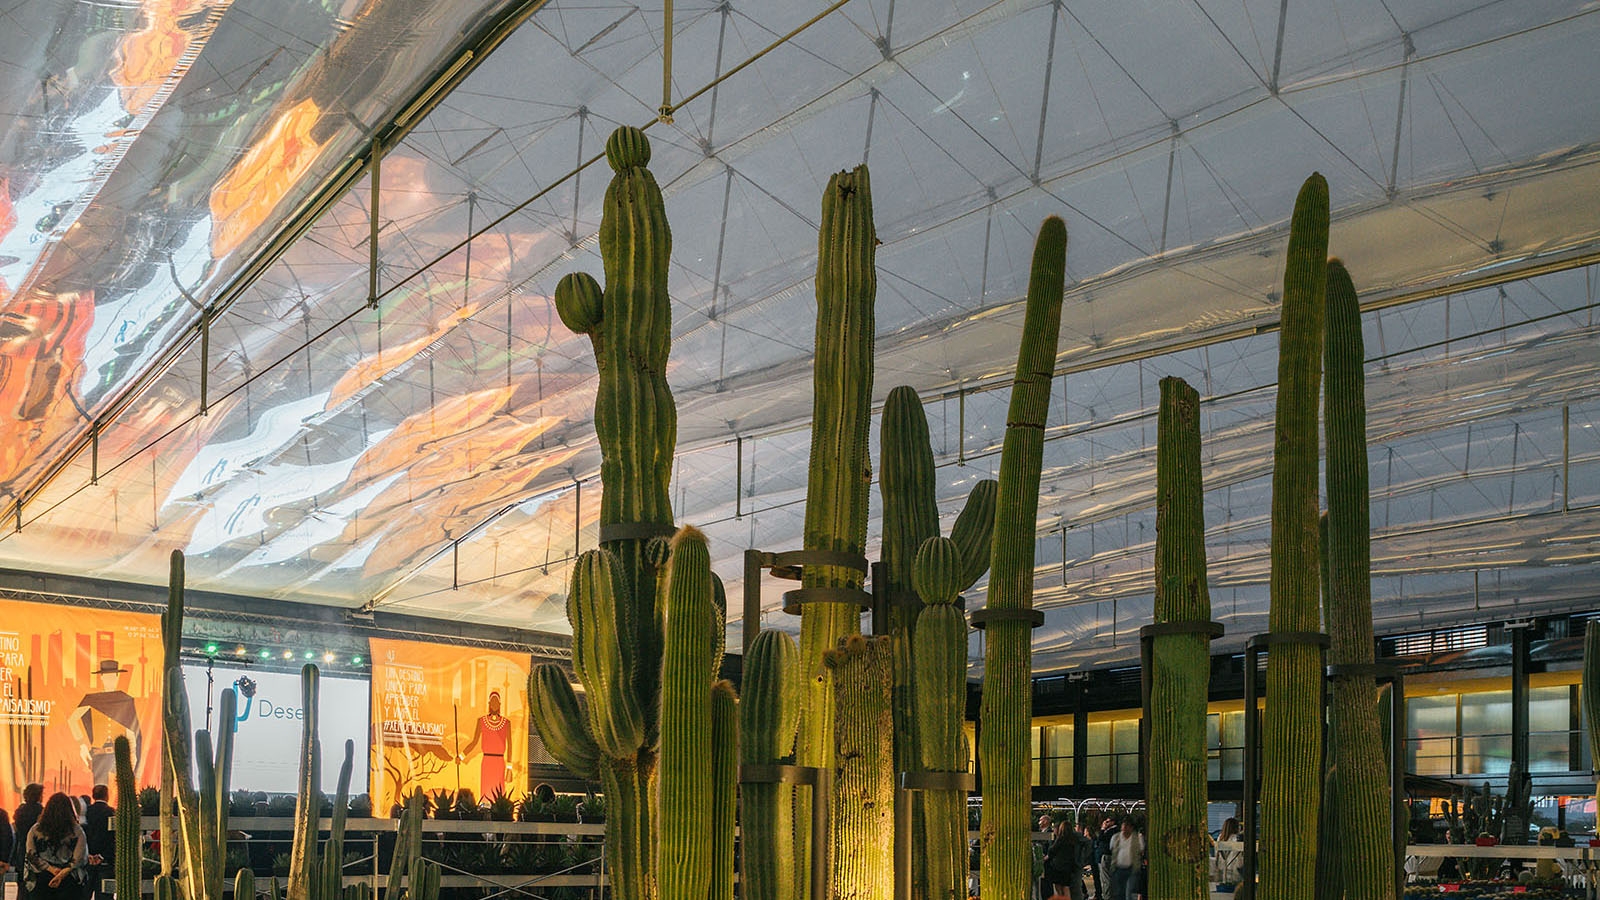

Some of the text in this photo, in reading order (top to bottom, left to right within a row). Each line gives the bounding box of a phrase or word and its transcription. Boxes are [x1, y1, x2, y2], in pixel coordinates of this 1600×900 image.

[4, 683, 13, 696] EL
[384, 706, 390, 718] Y
[412, 708, 420, 720] EL
